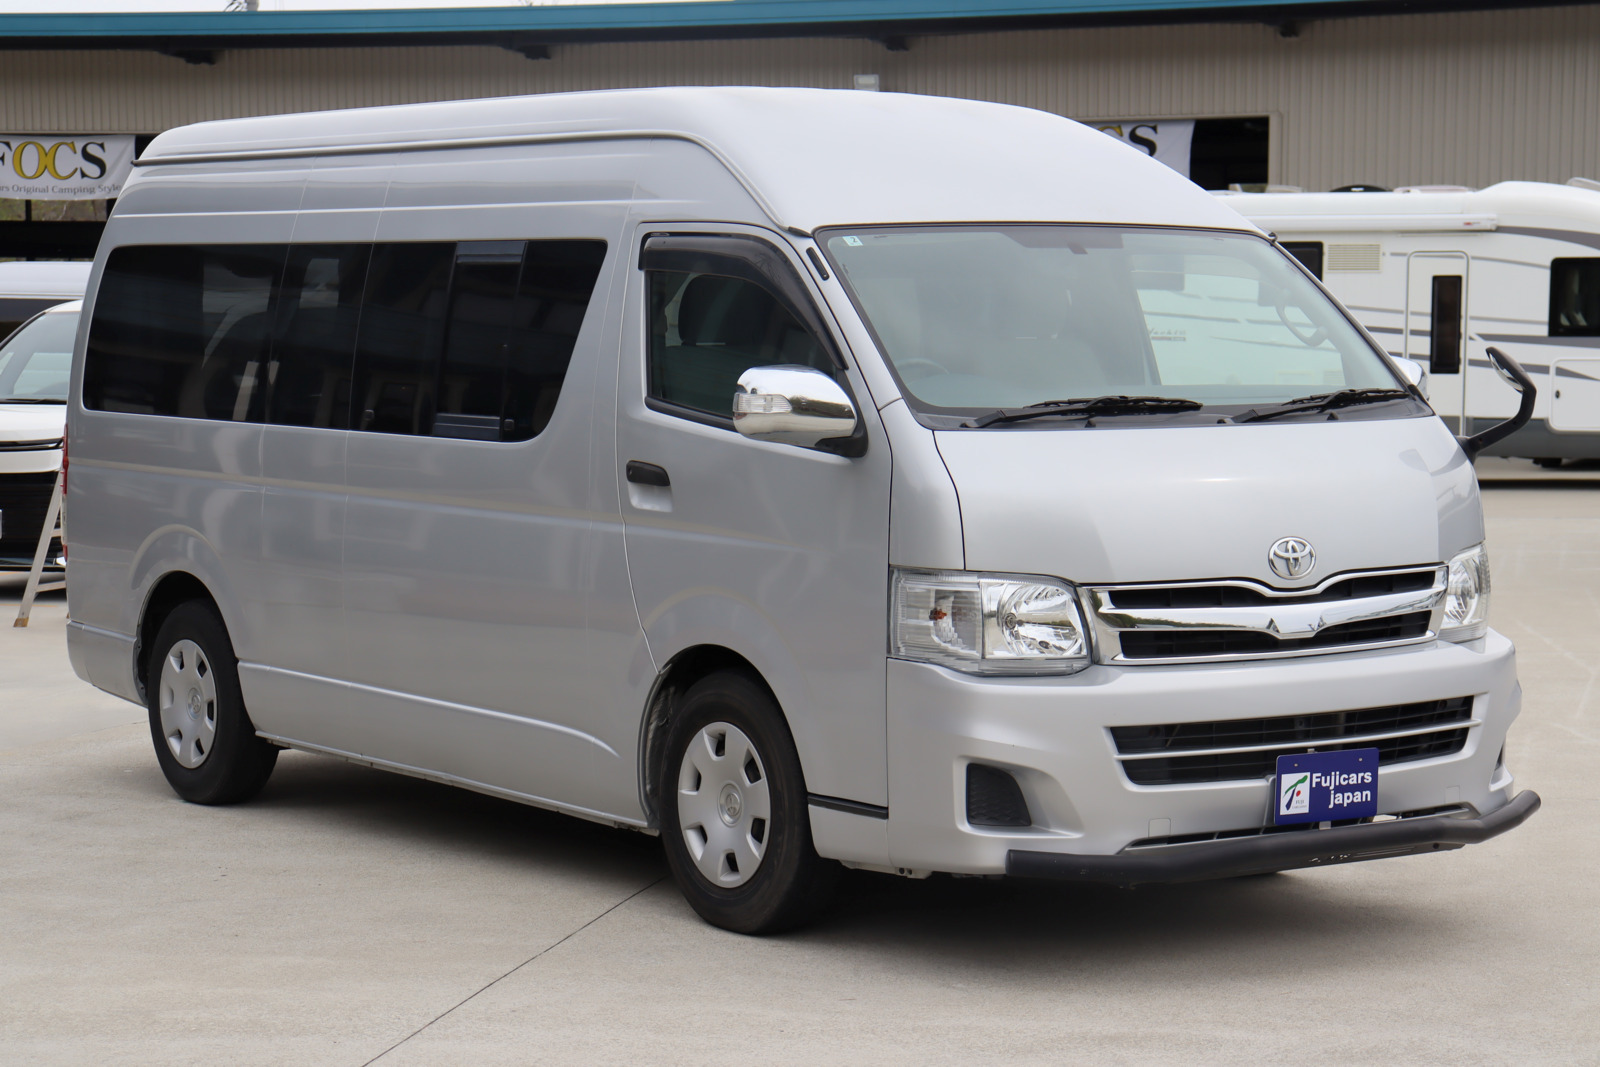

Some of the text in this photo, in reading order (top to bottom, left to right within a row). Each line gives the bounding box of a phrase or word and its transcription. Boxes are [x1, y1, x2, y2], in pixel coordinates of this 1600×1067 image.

[1097, 124, 1158, 157] S
[11, 184, 49, 195] Original
[51, 185, 96, 196] Camping
[97, 183, 121, 194] Style
[1311, 771, 1373, 790] Fujicars
[1328, 790, 1371, 809] japan
